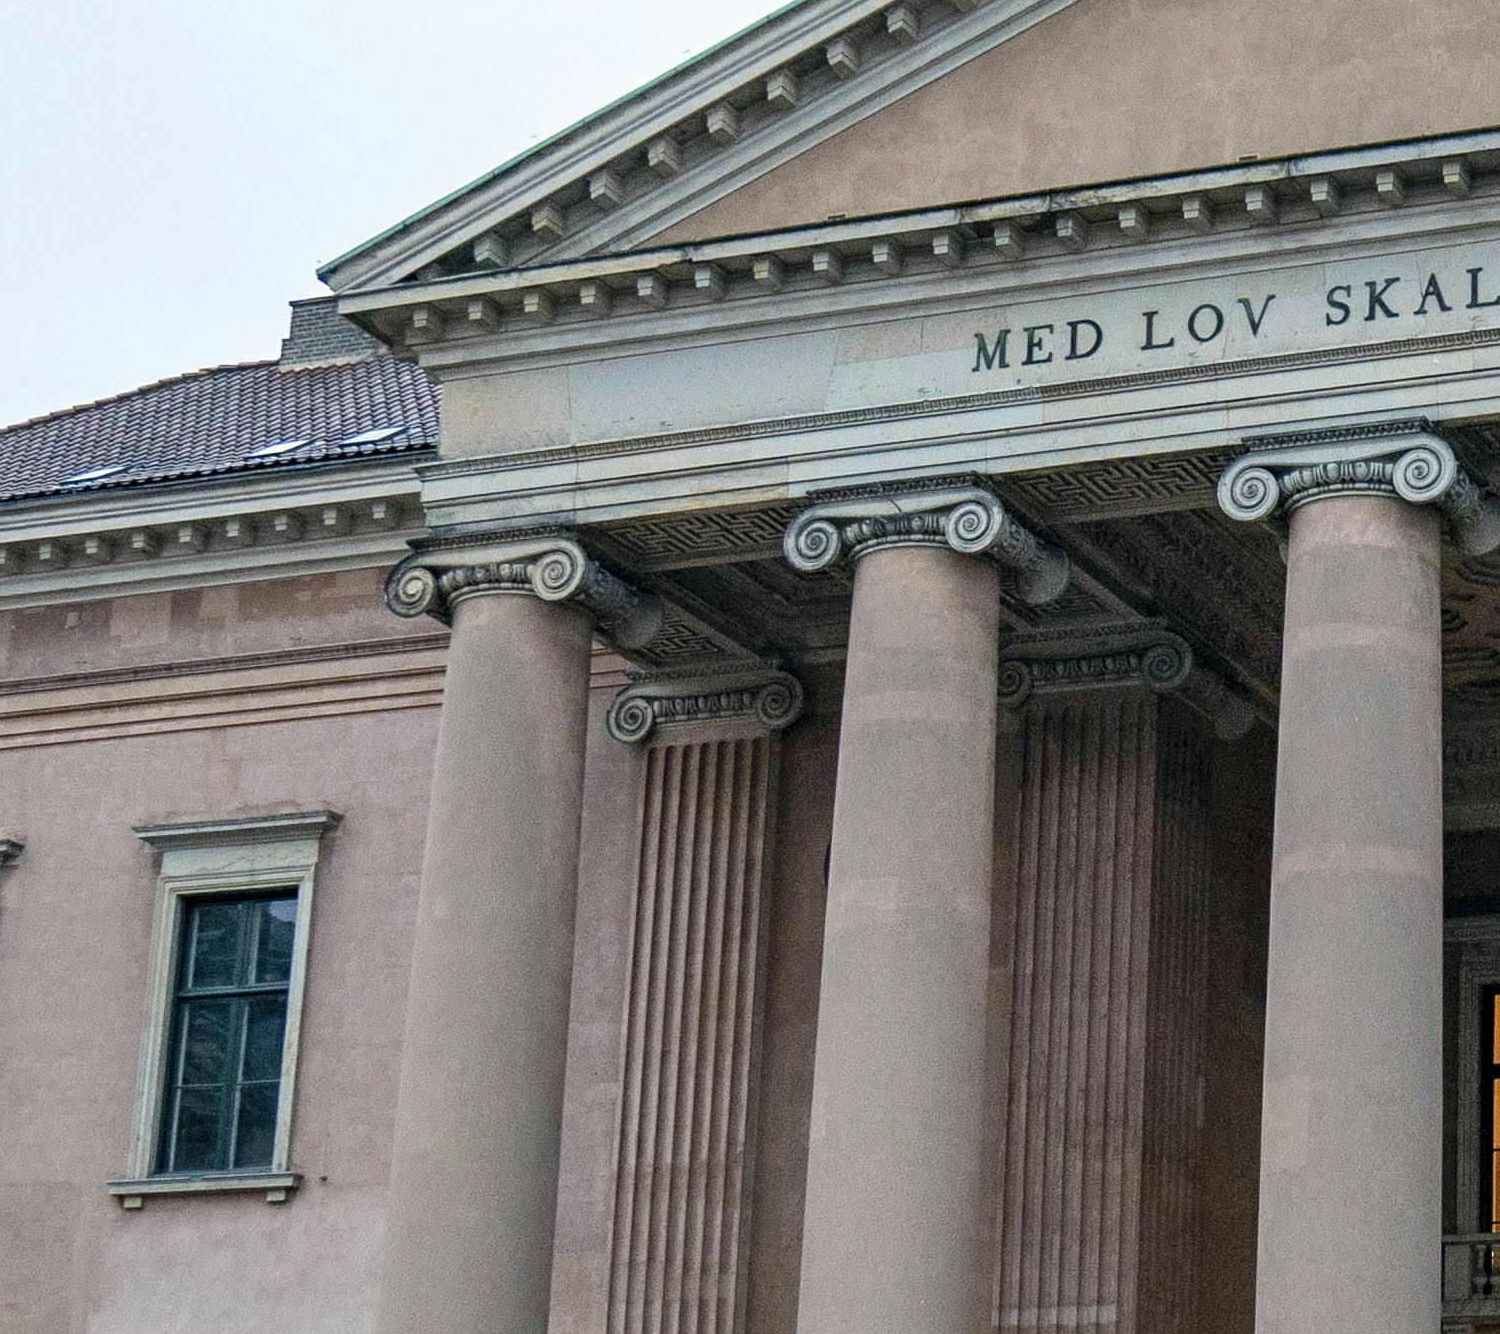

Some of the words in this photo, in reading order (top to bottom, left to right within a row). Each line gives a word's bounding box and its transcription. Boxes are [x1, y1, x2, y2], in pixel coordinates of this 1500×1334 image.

[972, 319, 1103, 373] MED
[1141, 295, 1275, 351] LOV
[1325, 268, 1500, 327] SKAL
